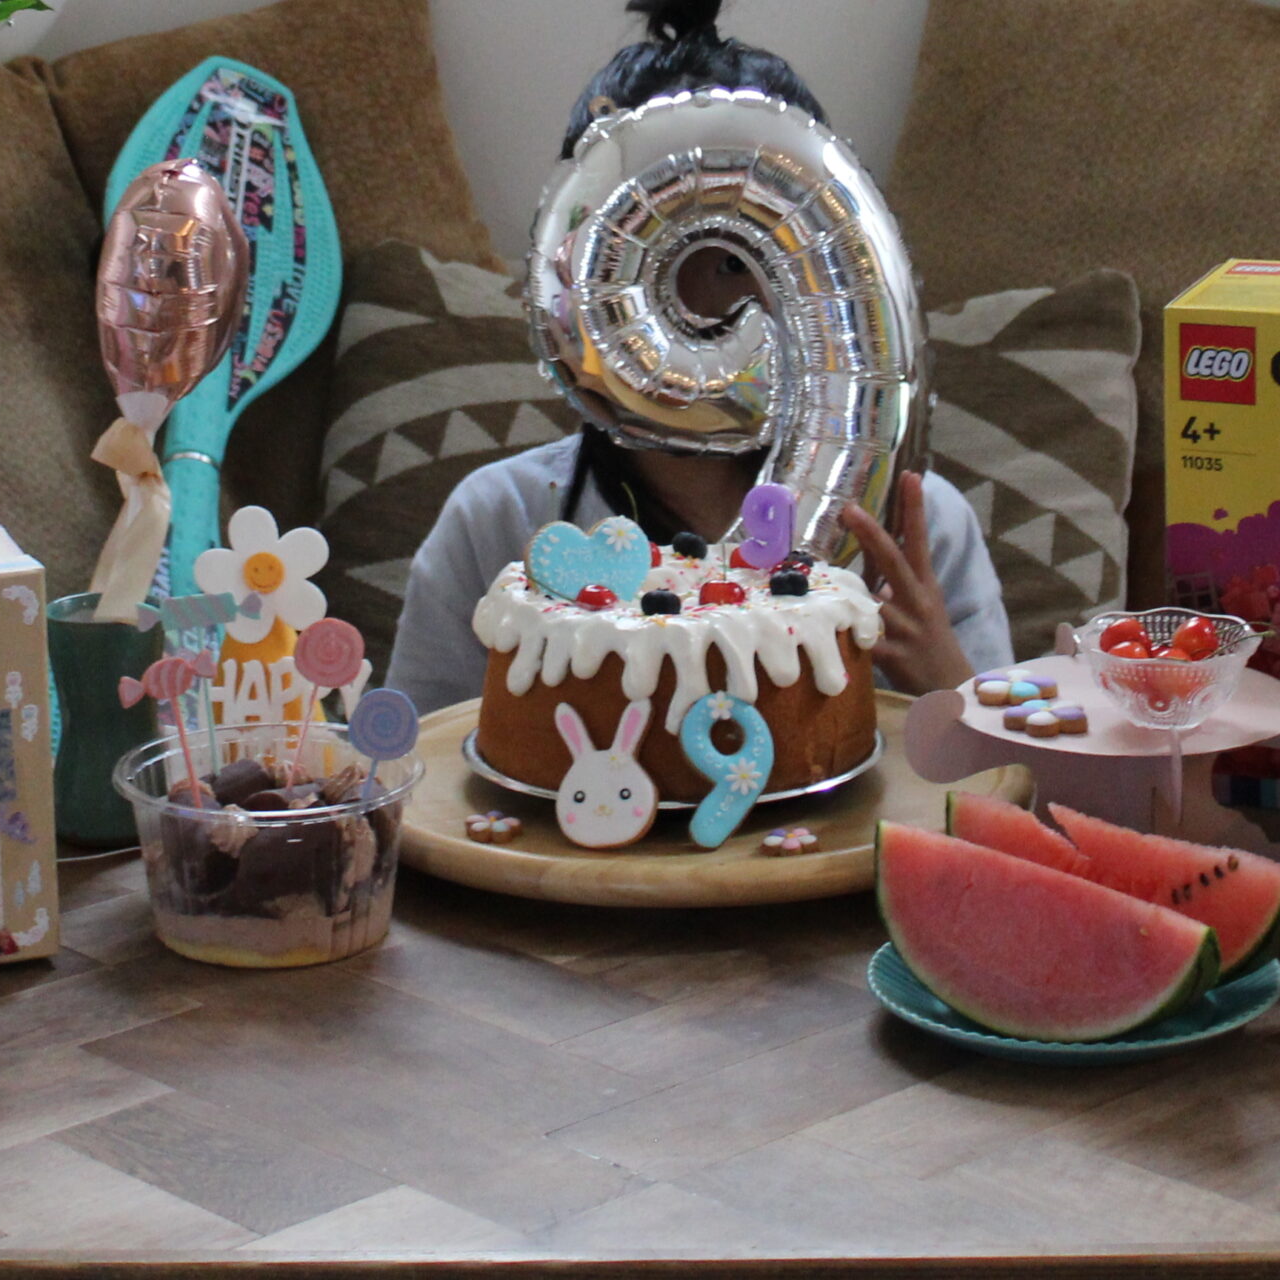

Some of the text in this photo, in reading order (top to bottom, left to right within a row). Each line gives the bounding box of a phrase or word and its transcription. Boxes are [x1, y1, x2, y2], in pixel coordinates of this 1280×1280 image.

[526, 86, 934, 566] 9
[1185, 347, 1251, 381] LEGO
[1181, 416, 1221, 444] 4+
[1181, 455, 1224, 472] 11035
[738, 482, 798, 569] 9
[679, 690, 775, 849] 9
